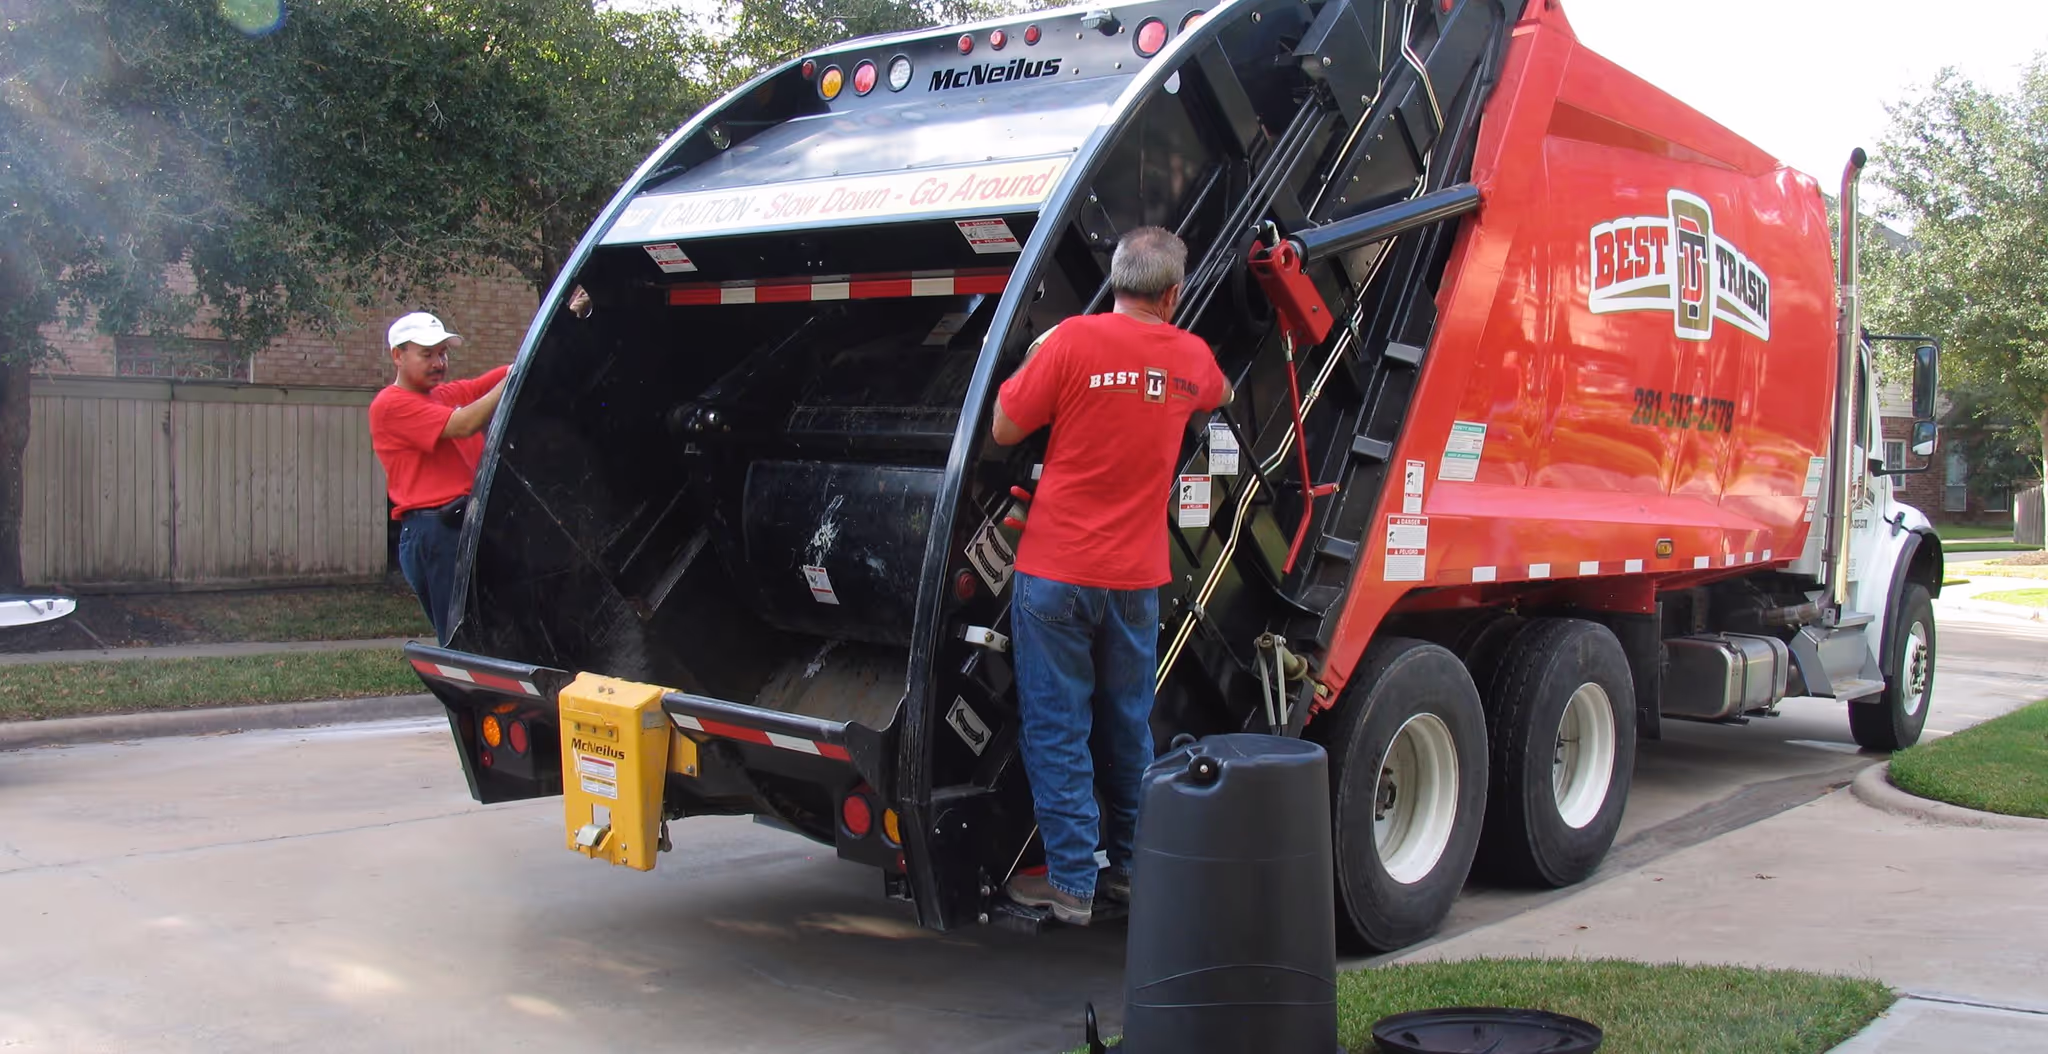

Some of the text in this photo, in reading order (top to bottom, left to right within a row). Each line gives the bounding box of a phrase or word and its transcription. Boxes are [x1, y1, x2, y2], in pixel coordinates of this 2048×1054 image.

[928, 58, 1062, 92] McNeilus
[660, 195, 757, 228] CAUTION
[763, 192, 821, 220] Slow
[818, 187, 891, 214] Down
[909, 177, 949, 206] Go
[948, 165, 1057, 203] Around
[1594, 225, 1669, 291] BEST
[1715, 243, 1768, 322] TRASH
[1089, 371, 1140, 388] BEST
[571, 737, 625, 760] McNeilus
